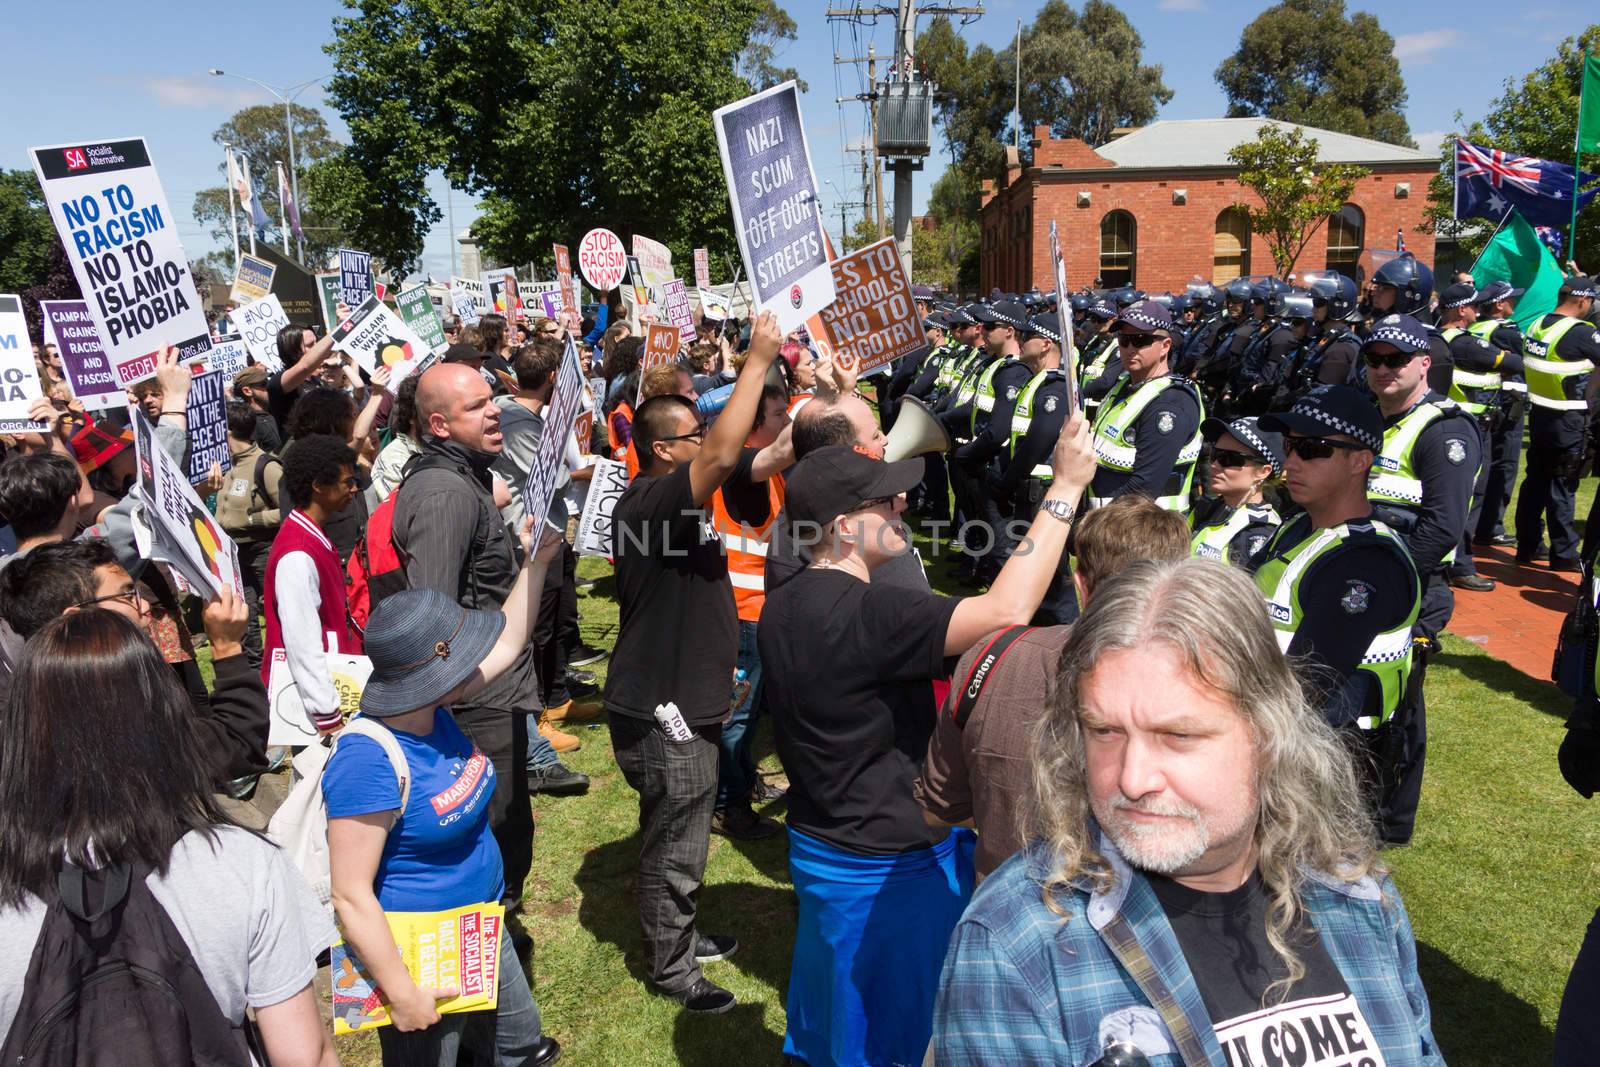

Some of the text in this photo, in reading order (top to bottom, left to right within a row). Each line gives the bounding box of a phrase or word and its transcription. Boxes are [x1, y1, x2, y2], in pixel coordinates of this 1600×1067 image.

[745, 115, 783, 157] NAZI
[66, 150, 87, 168] SA
[86, 146, 113, 157] Socialist
[90, 154, 125, 166] Alternative
[751, 155, 794, 199] SCUM
[61, 184, 134, 230] NO TO
[749, 189, 812, 249] OFF OUR
[72, 204, 165, 259] RACISM
[585, 231, 617, 252] STOP
[84, 239, 153, 289] NO TO
[341, 252, 370, 274] UNITY
[581, 251, 625, 269] RACISM
[756, 230, 819, 289] STREETS
[831, 245, 896, 295] ES TO
[96, 260, 186, 317] ISLAMO-
[345, 271, 368, 290] IN THE
[588, 268, 622, 286] NOW
[343, 288, 360, 304] FACE
[398, 286, 426, 306] MUSLIMS
[822, 271, 905, 322] SCHOOLS
[52, 311, 91, 323] CAMPAI
[105, 288, 190, 346] PHOBIA
[243, 302, 273, 325] #NO
[411, 302, 425, 316] ARE
[831, 293, 909, 345] NO TO
[62, 326, 98, 338] AGAINS
[245, 316, 287, 346] ROOM
[350, 313, 387, 349] RECLAIM
[360, 324, 390, 351] WHAT?
[430, 333, 443, 346] NOT
[838, 316, 917, 369] BIGOTRY
[211, 350, 243, 363] RACISM
[264, 342, 280, 361] FO
[881, 350, 896, 362] FOR
[895, 339, 921, 355] RACISM
[1525, 339, 1547, 356] Police
[83, 357, 102, 369] AND
[227, 359, 236, 367] TO
[187, 400, 222, 430] IN THE
[191, 420, 228, 452] ACE OF
[190, 442, 231, 475] TERROR
[1381, 458, 1397, 469] lice
[586, 464, 630, 554] RACISM
[1268, 603, 1289, 620] lice
[968, 654, 995, 698] Canon
[341, 685, 351, 705] CAN
[672, 713, 682, 728] TO
[436, 775, 472, 808] MARCH
[466, 758, 482, 780] FOR
[484, 917, 495, 937] THE
[464, 913, 483, 992] THE SOCIALIST
[420, 945, 437, 992] GENDE
[1221, 1013, 1368, 1067] LCOME
